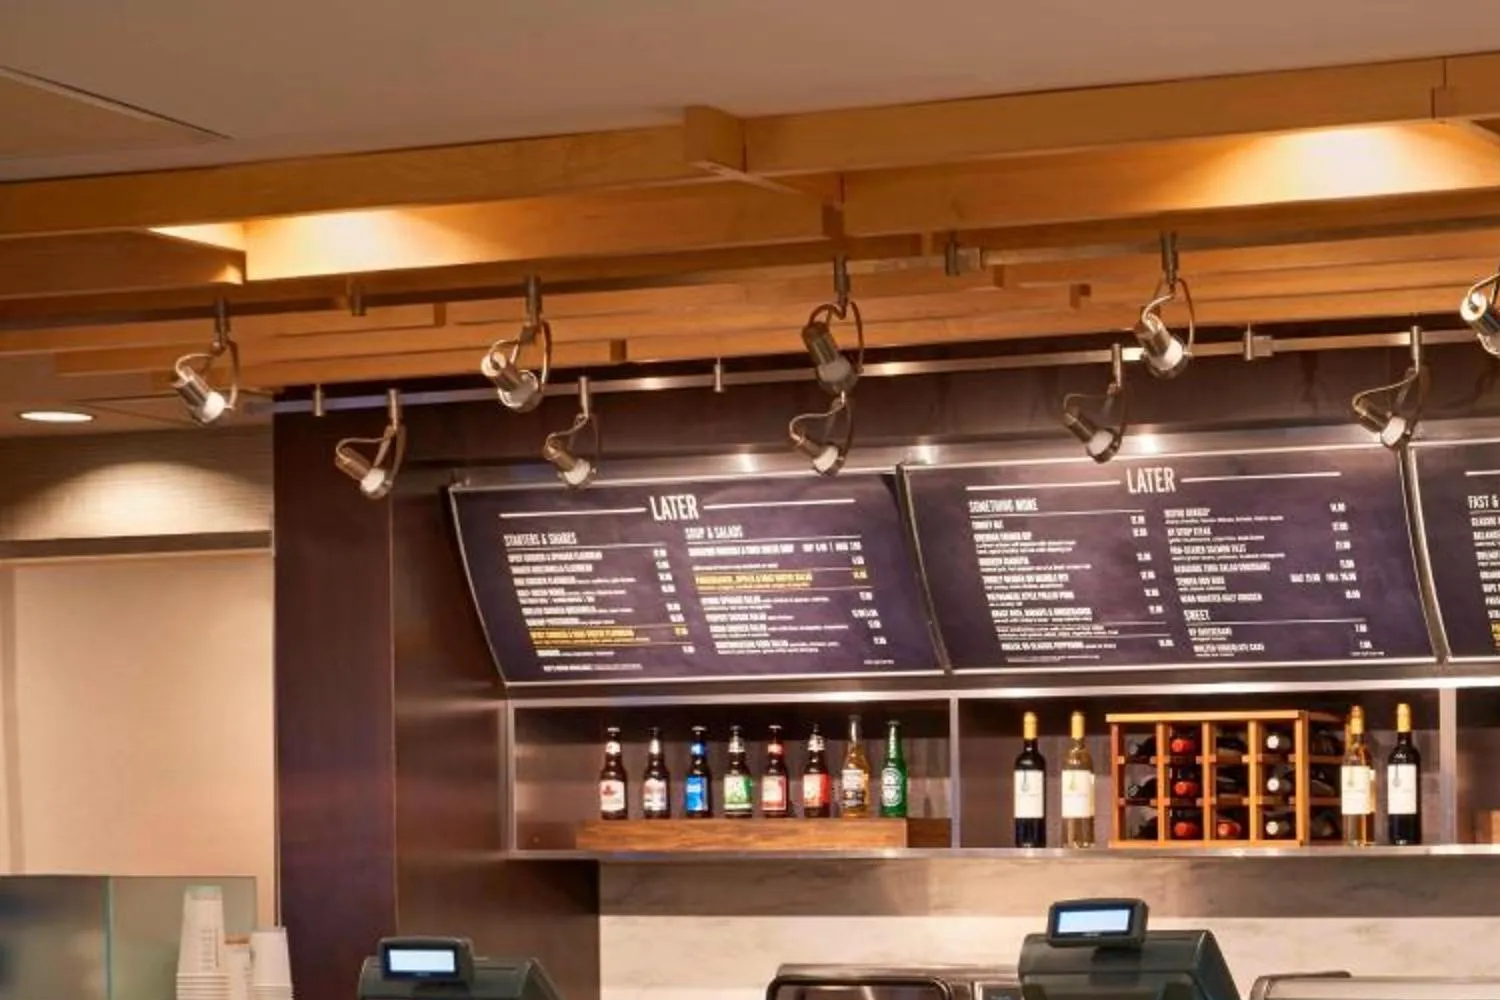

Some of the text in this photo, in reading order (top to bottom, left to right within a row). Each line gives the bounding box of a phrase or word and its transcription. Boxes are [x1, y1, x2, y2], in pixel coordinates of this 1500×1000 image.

[1127, 468, 1175, 493] LATER
[650, 494, 699, 521] LATER
[1468, 495, 1489, 509] FAST
[1491, 495, 1499, 508] &
